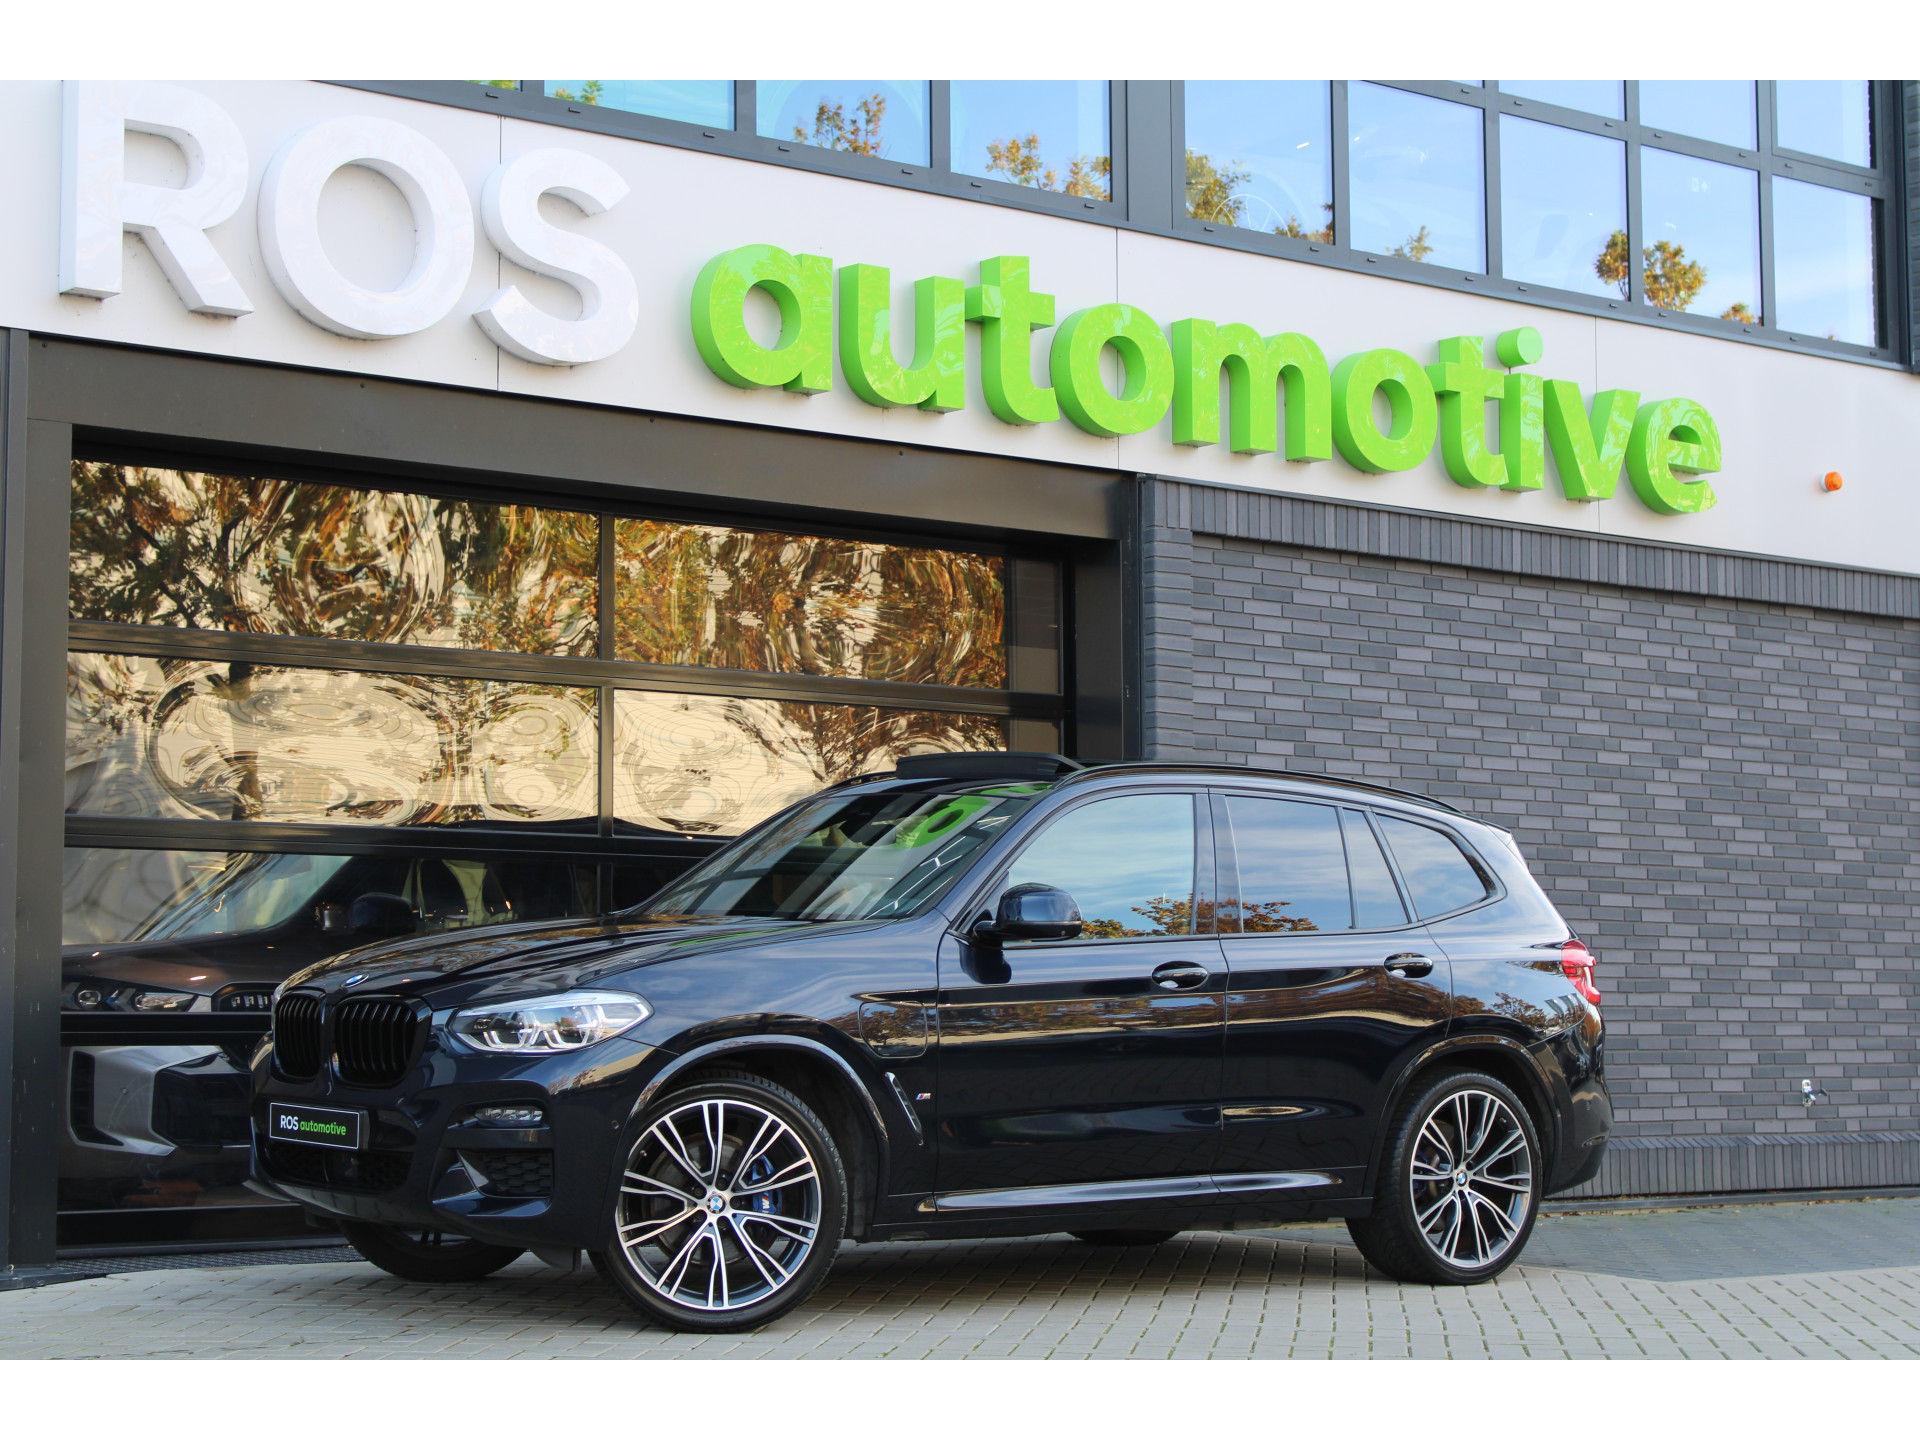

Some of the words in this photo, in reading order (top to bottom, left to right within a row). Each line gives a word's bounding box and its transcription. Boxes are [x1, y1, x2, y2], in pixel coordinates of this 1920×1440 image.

[59, 80, 640, 367] ROS
[691, 245, 1722, 515] automotive
[280, 1114, 299, 1131] ROS
[300, 1120, 347, 1136] automotive
